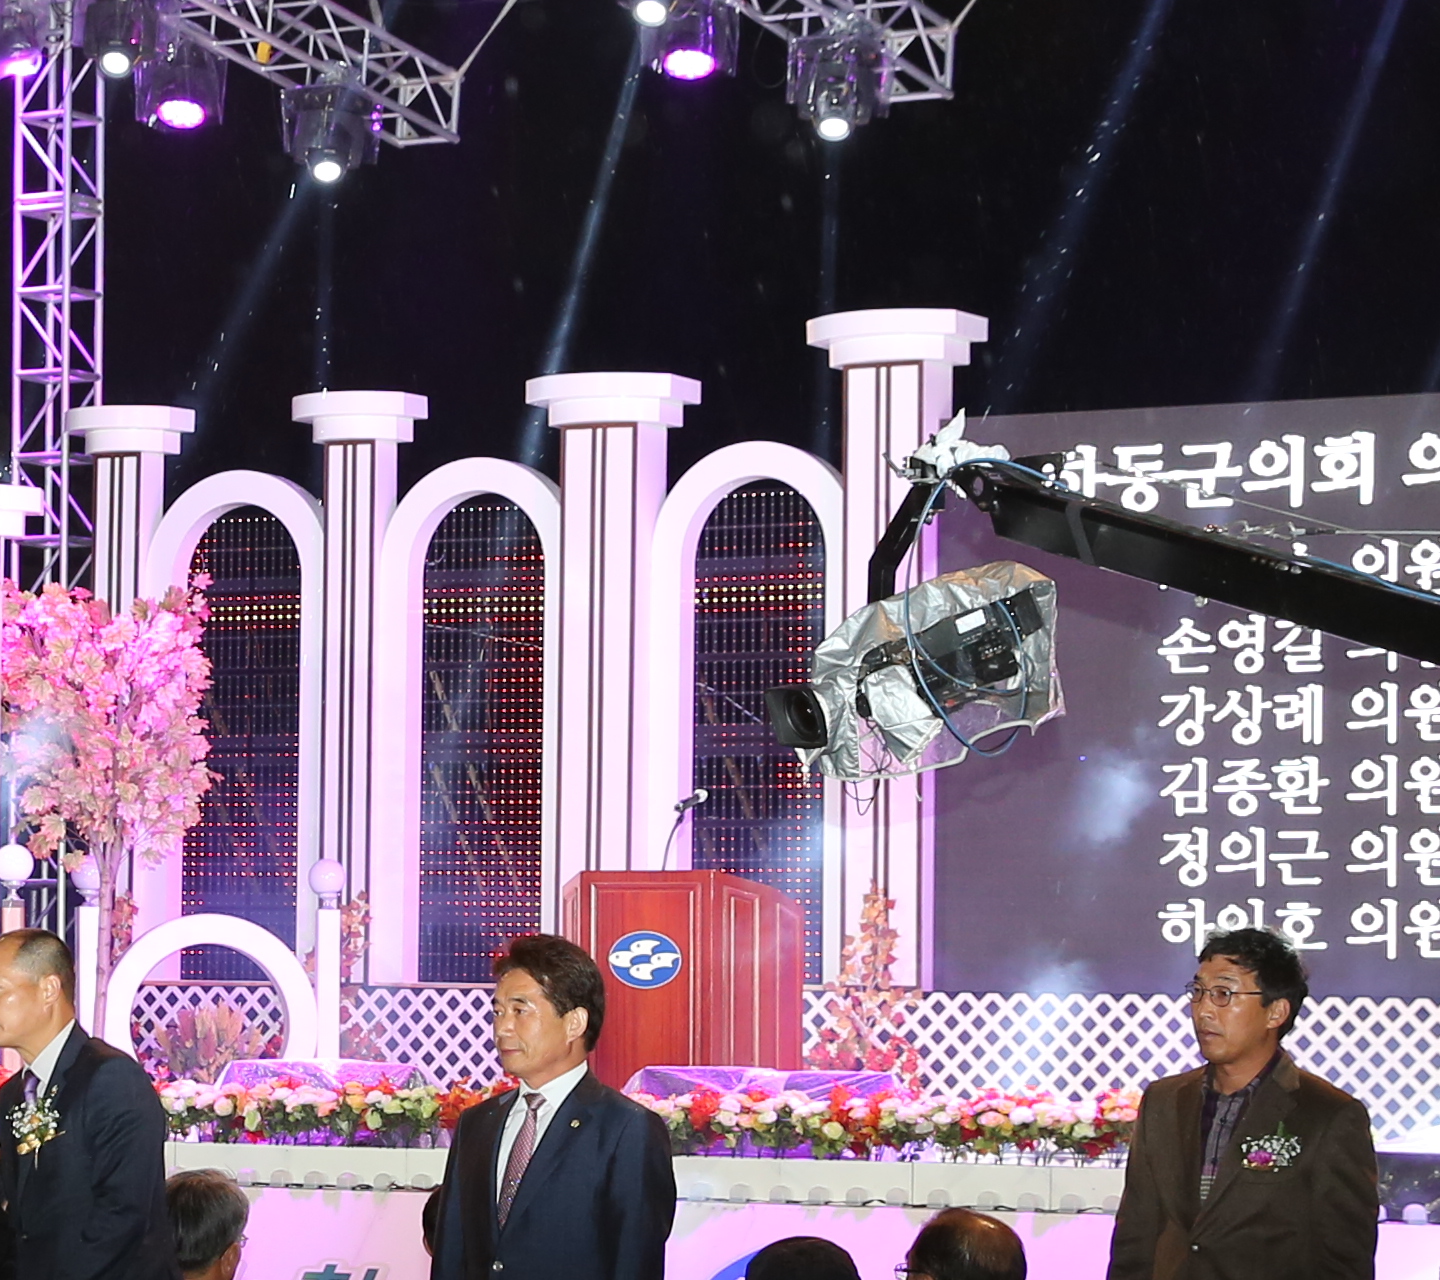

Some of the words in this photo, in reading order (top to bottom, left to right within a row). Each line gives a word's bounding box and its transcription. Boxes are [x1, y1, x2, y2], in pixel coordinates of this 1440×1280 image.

[1157, 614, 1324, 674] 손영길
[1158, 683, 1324, 747] 강상례
[1160, 756, 1330, 817] 김종환
[1159, 826, 1329, 887] 정의근
